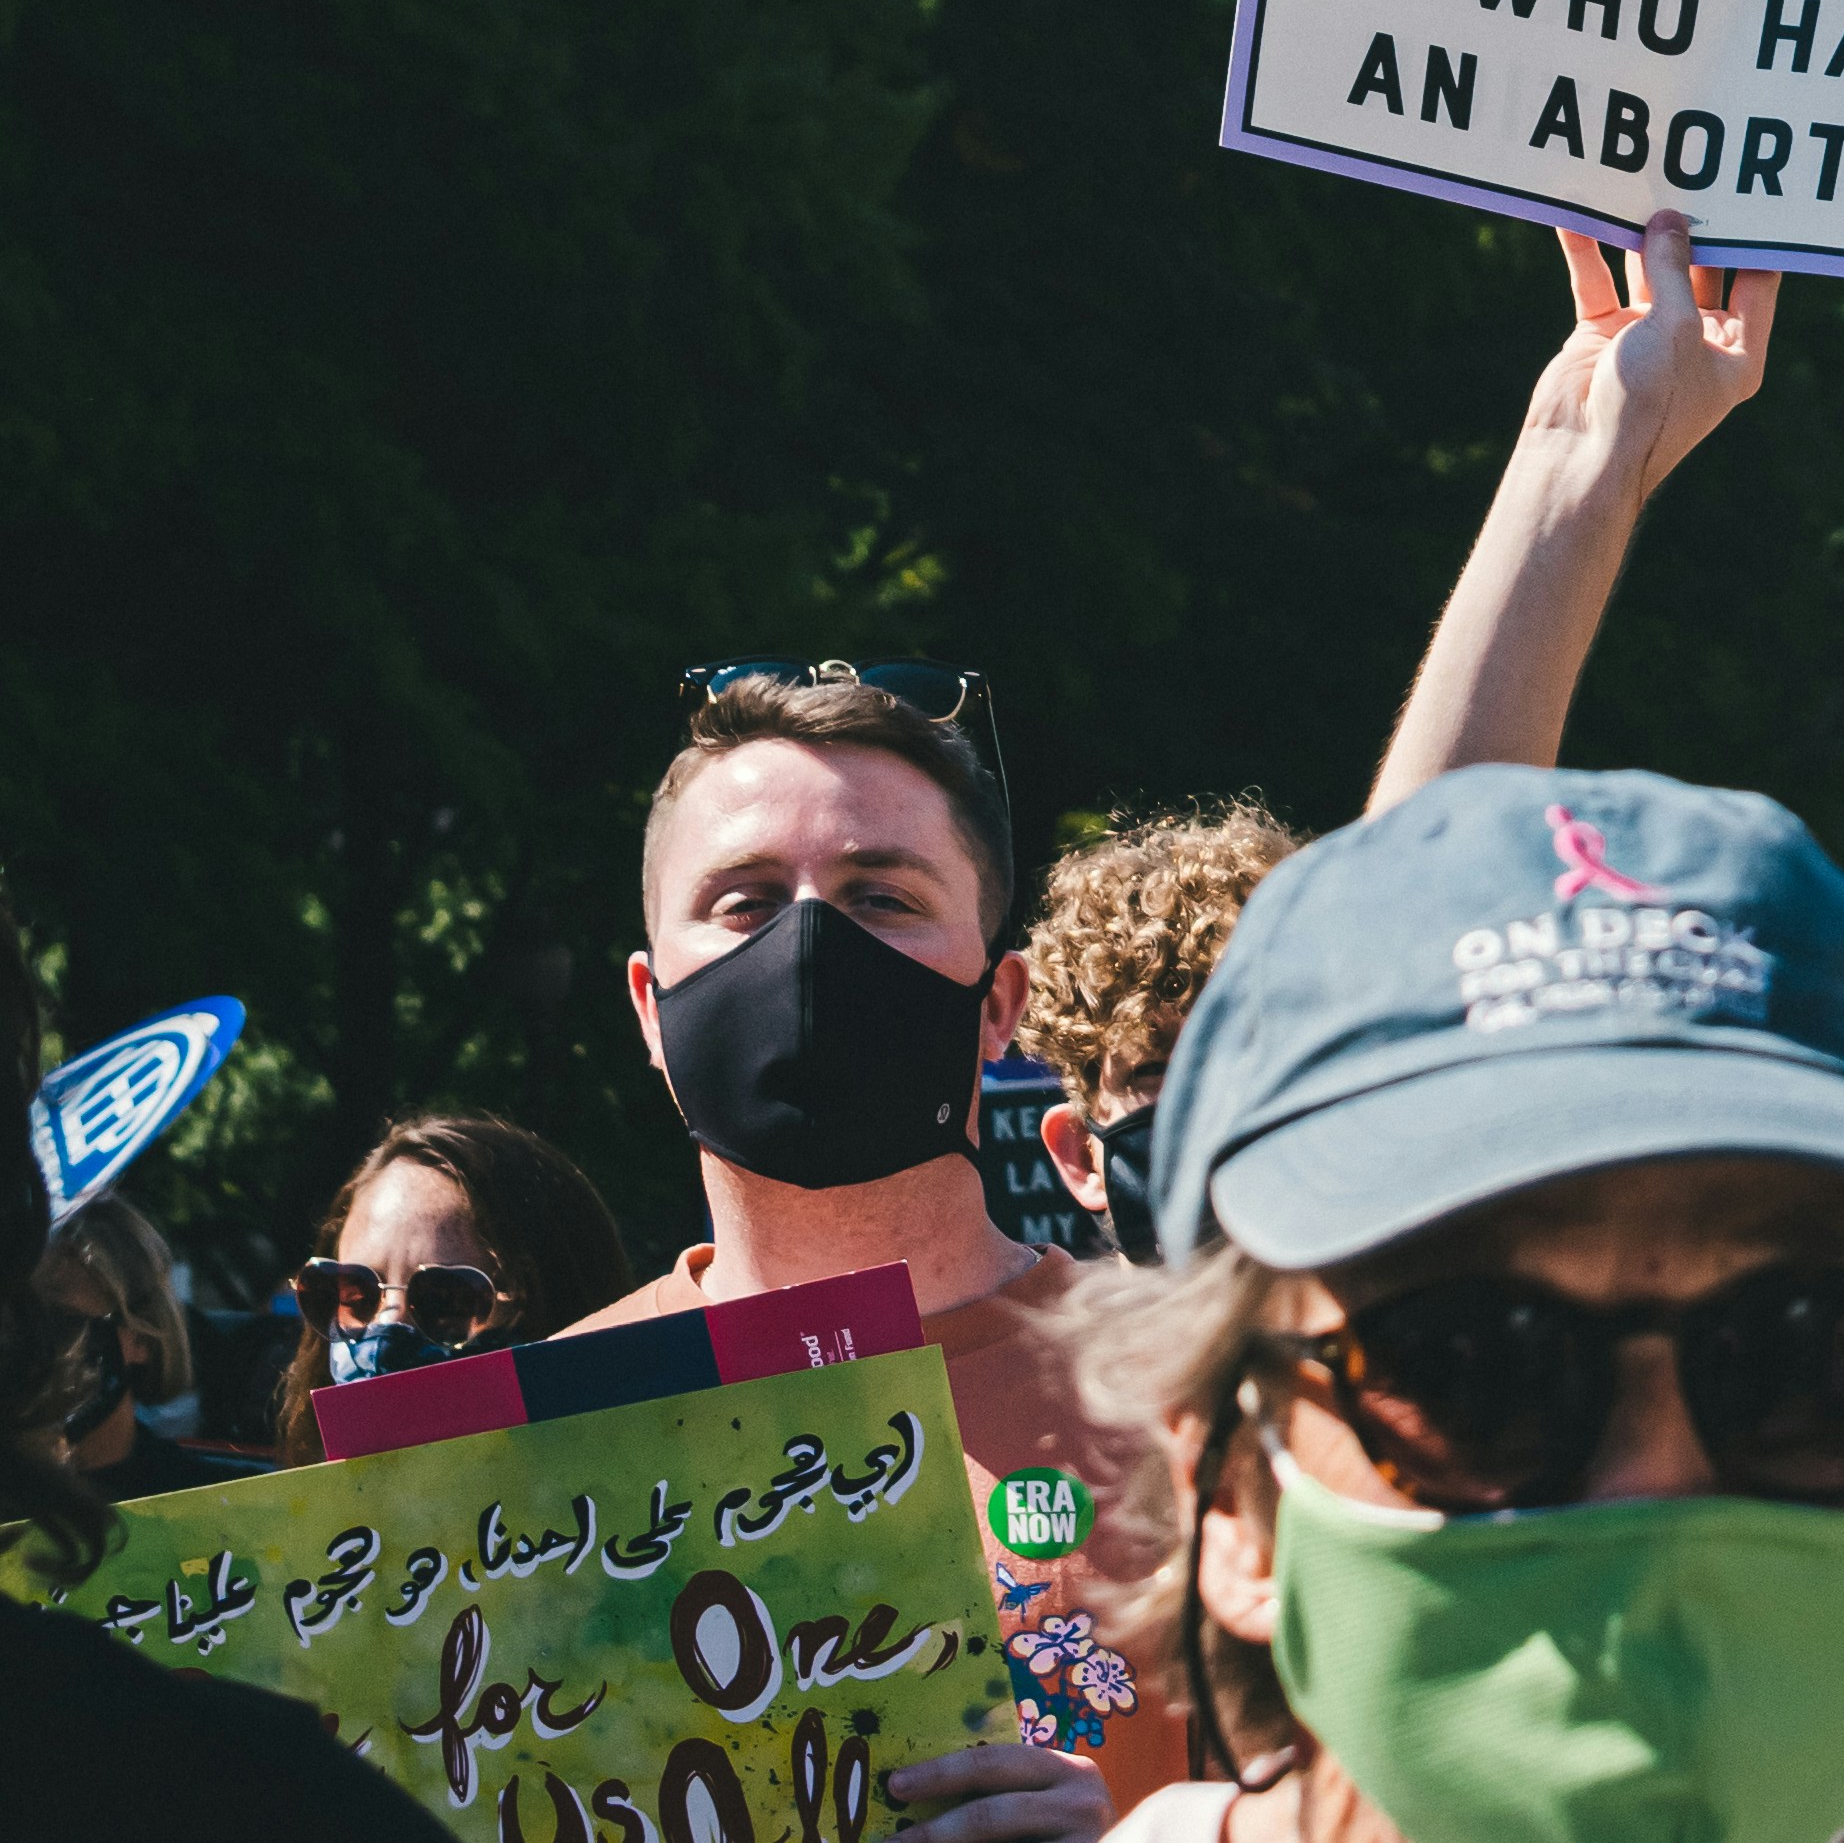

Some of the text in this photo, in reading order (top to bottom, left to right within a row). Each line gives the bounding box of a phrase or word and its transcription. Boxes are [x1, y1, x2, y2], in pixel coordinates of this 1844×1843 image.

[1346, 31, 1478, 131] AN
[1453, 912, 1558, 971] ON
[992, 1105, 1053, 1140] KE
[1007, 1161, 1053, 1193] LA
[713, 1433, 830, 1547] هجوم
[1006, 1480, 1076, 1513] ERA
[1008, 1512, 1076, 1544] NOW
[284, 1526, 380, 1648] هجوم
[401, 1604, 607, 1807] for
